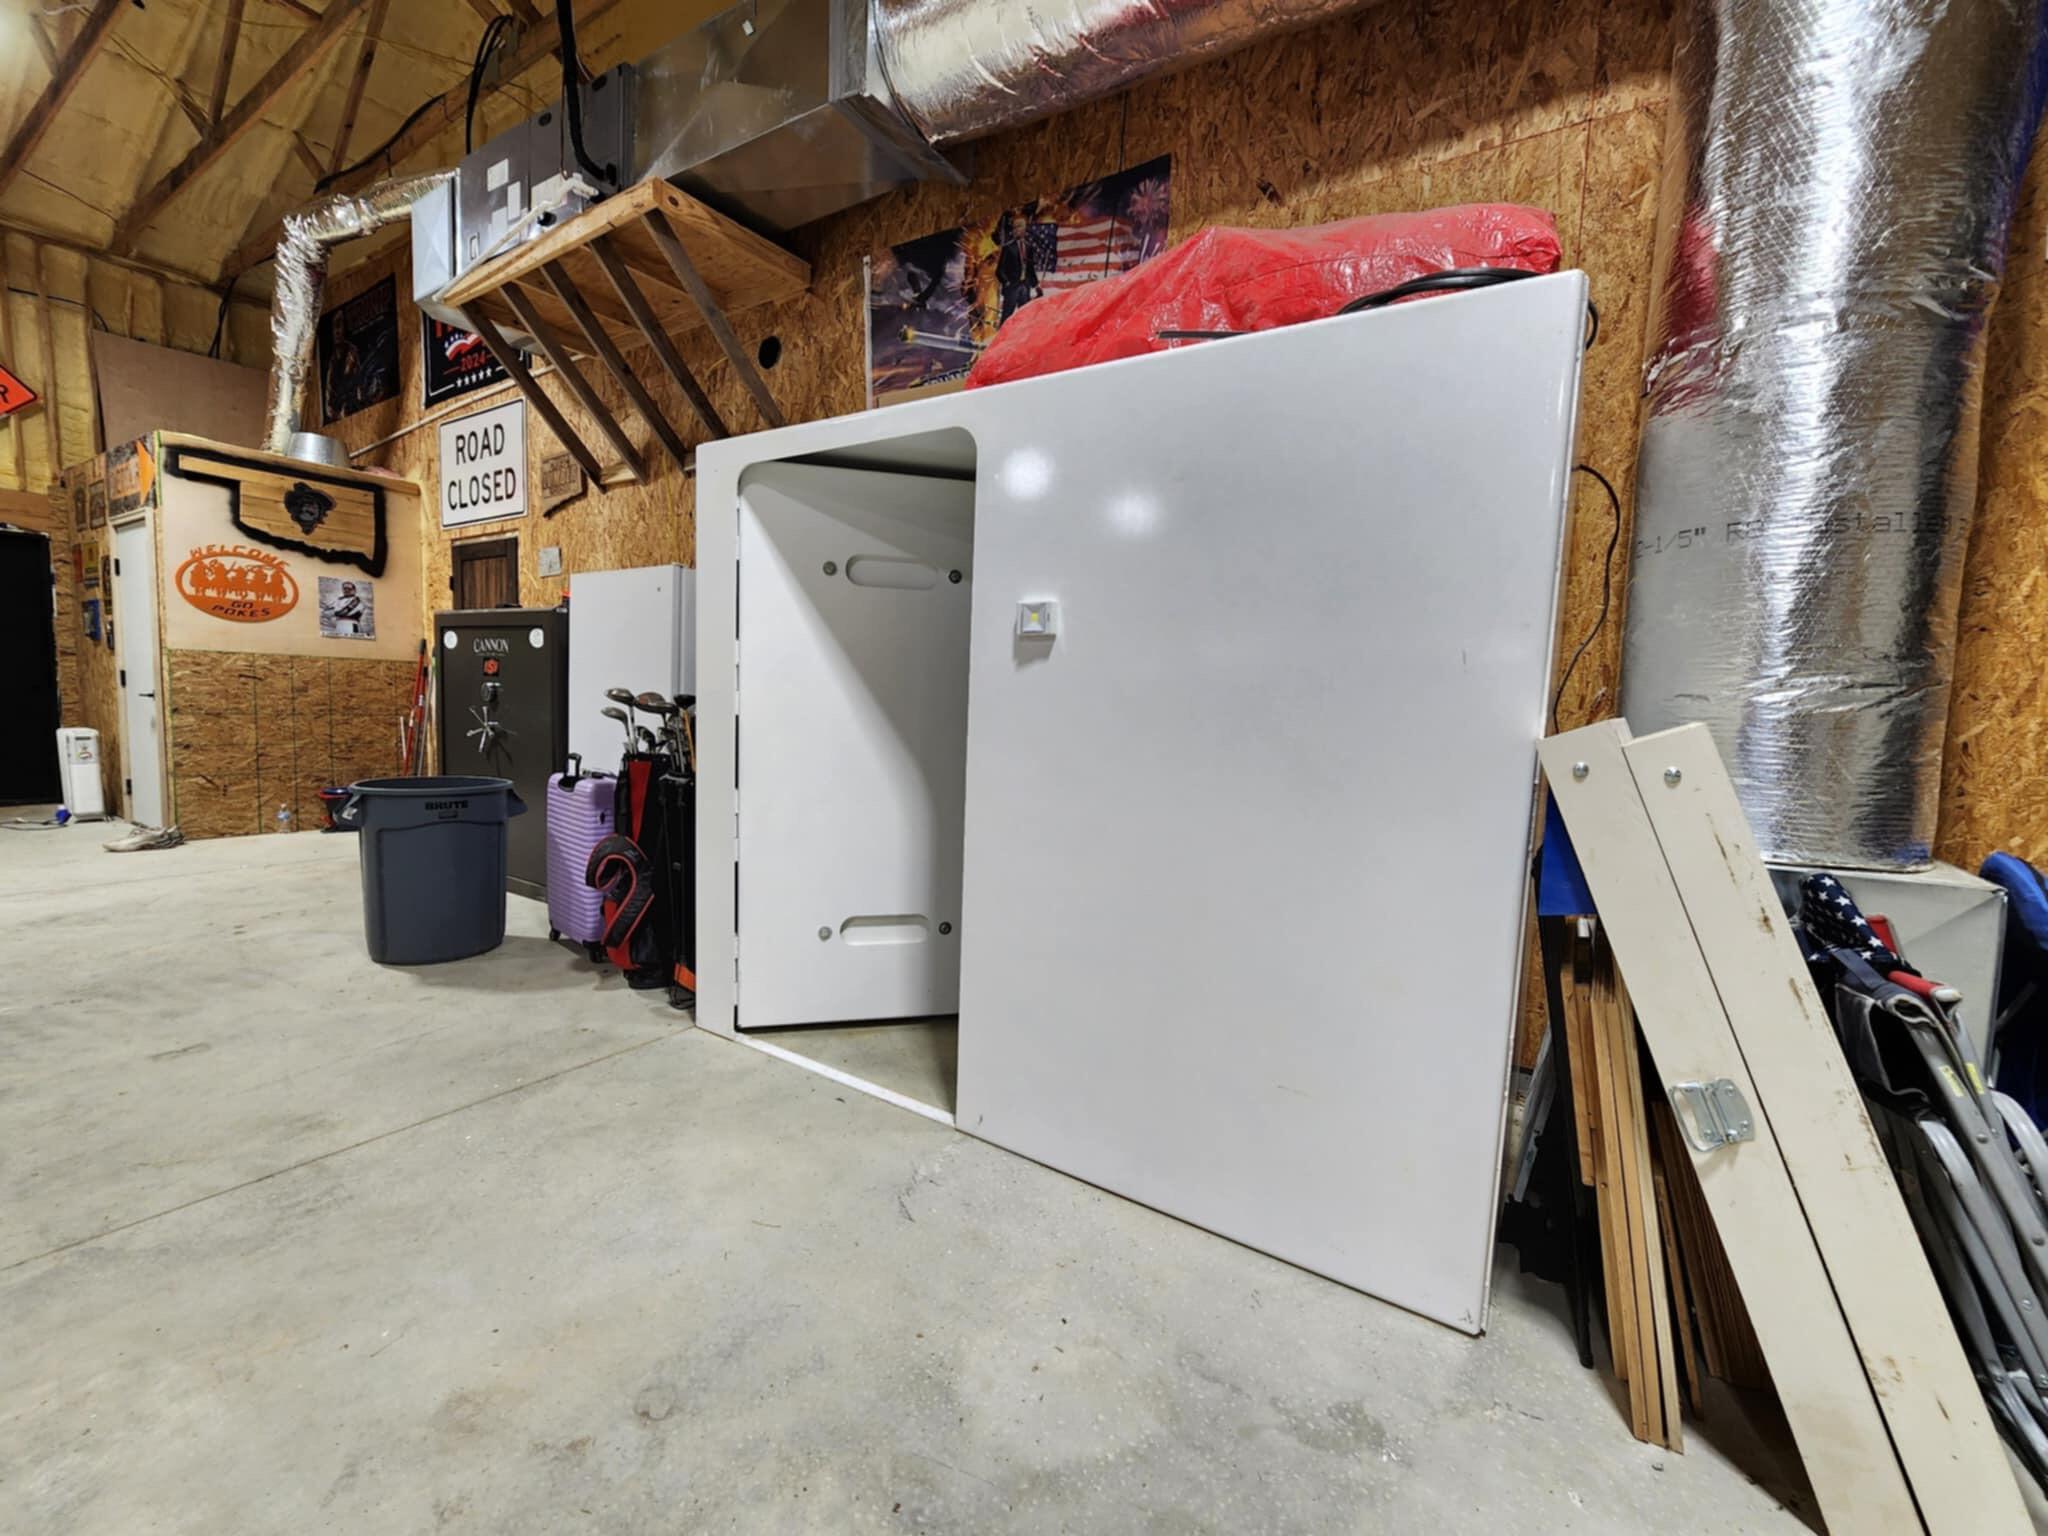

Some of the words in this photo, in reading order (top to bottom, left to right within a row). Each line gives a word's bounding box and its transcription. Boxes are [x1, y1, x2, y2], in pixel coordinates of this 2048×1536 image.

[461, 350, 487, 372] 2024
[455, 423, 505, 465] ROAD
[447, 467, 517, 511] CLOSED
[189, 543, 291, 571] WELCOME
[211, 604, 271, 618] POKES
[231, 600, 254, 609] GO
[472, 637, 510, 653] CANNON
[424, 799, 469, 810] BRUTE
